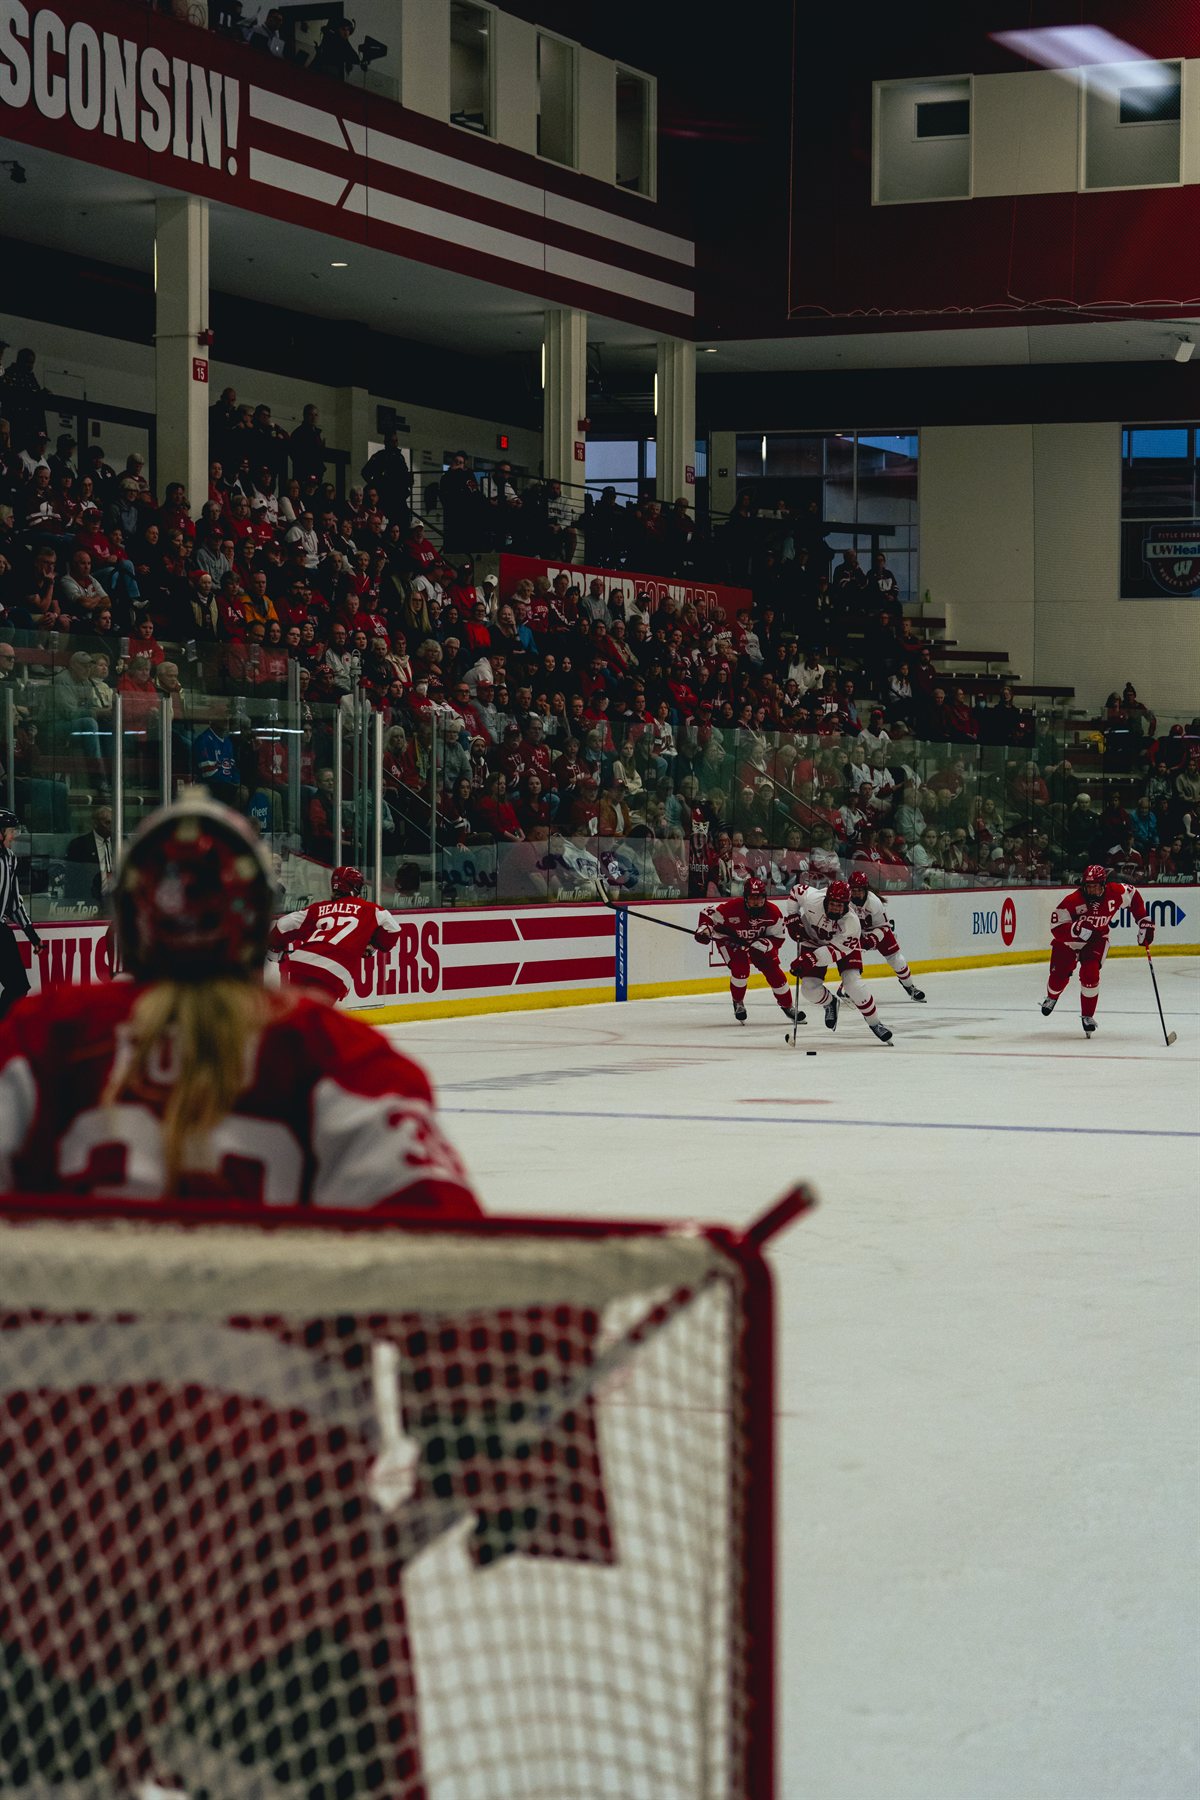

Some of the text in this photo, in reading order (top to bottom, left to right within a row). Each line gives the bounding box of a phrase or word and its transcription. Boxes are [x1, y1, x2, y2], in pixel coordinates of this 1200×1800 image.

[197, 367, 205, 380] 15
[318, 903, 361, 917] HEALEY
[307, 916, 359, 945] 27
[972, 911, 998, 936] BMO
